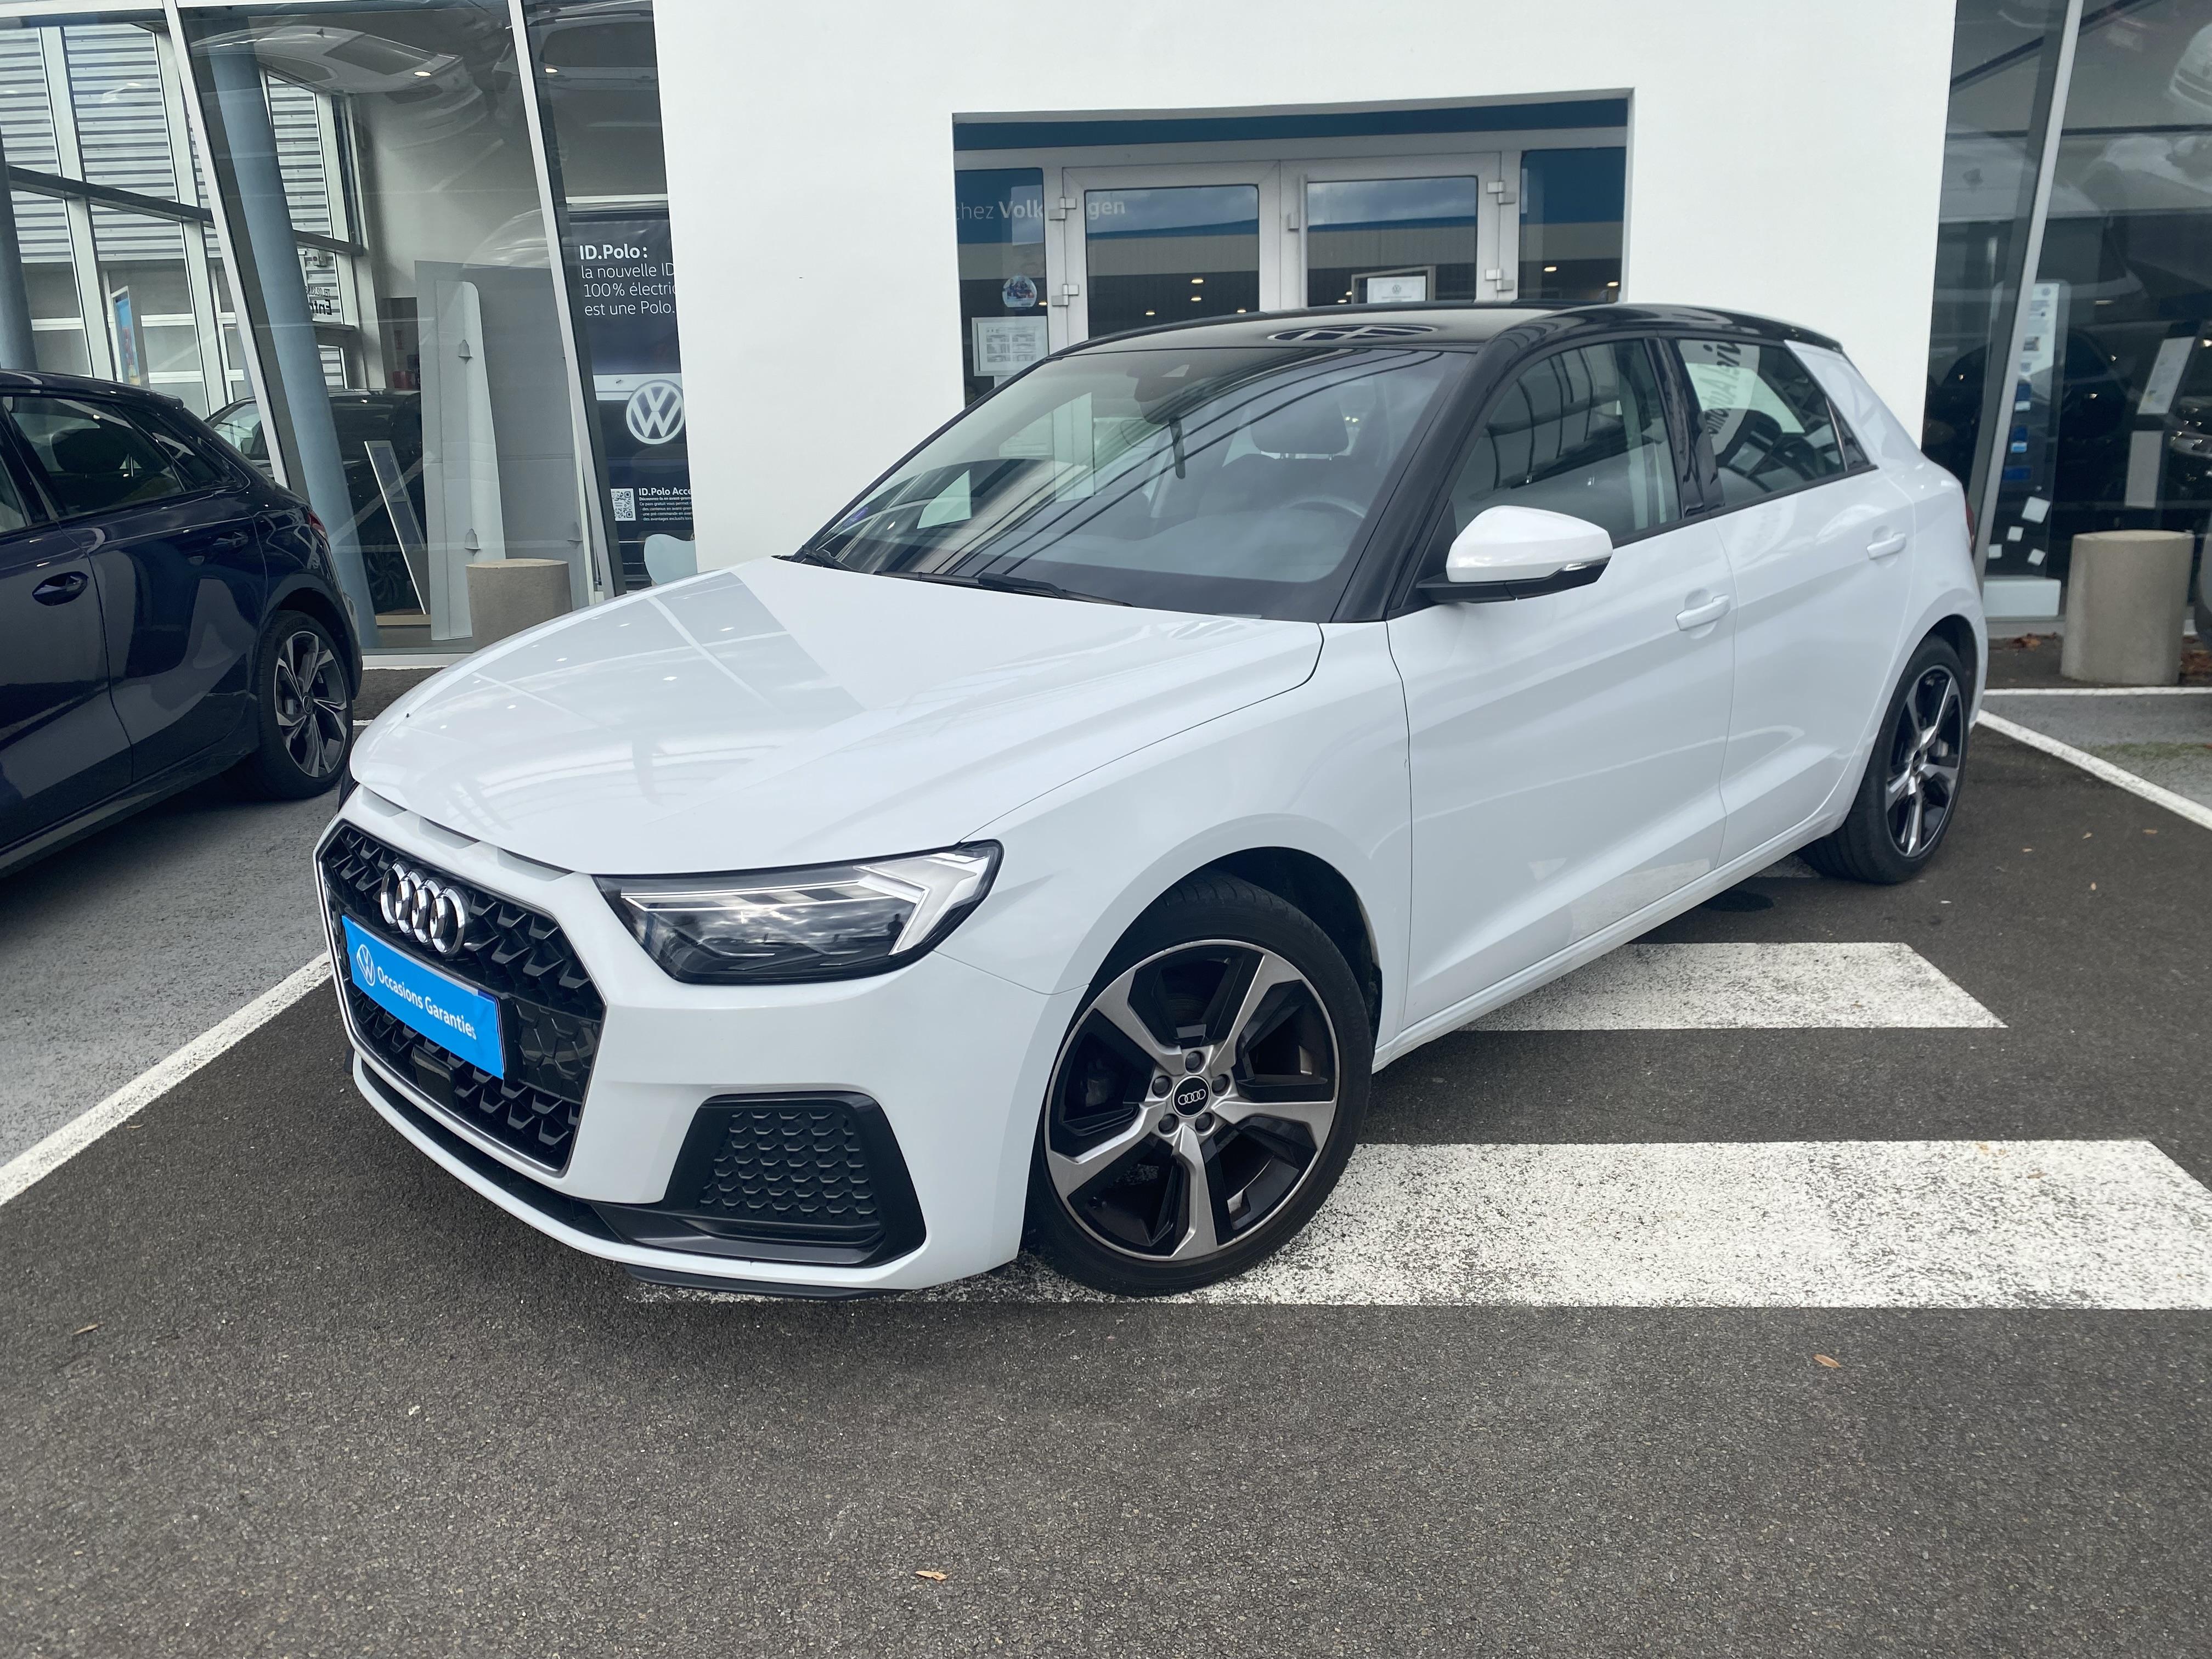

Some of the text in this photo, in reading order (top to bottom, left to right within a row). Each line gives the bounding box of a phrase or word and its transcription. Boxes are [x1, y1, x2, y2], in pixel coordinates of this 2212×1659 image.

[998, 200, 1125, 220] Volkgen
[581, 265, 594, 279] la
[597, 263, 657, 278] nouvelle
[583, 282, 625, 298] 100%
[584, 300, 675, 316] est une Polo.
[639, 487, 670, 495] ID.Polo
[377, 966, 477, 1041] Occasions Garanties
